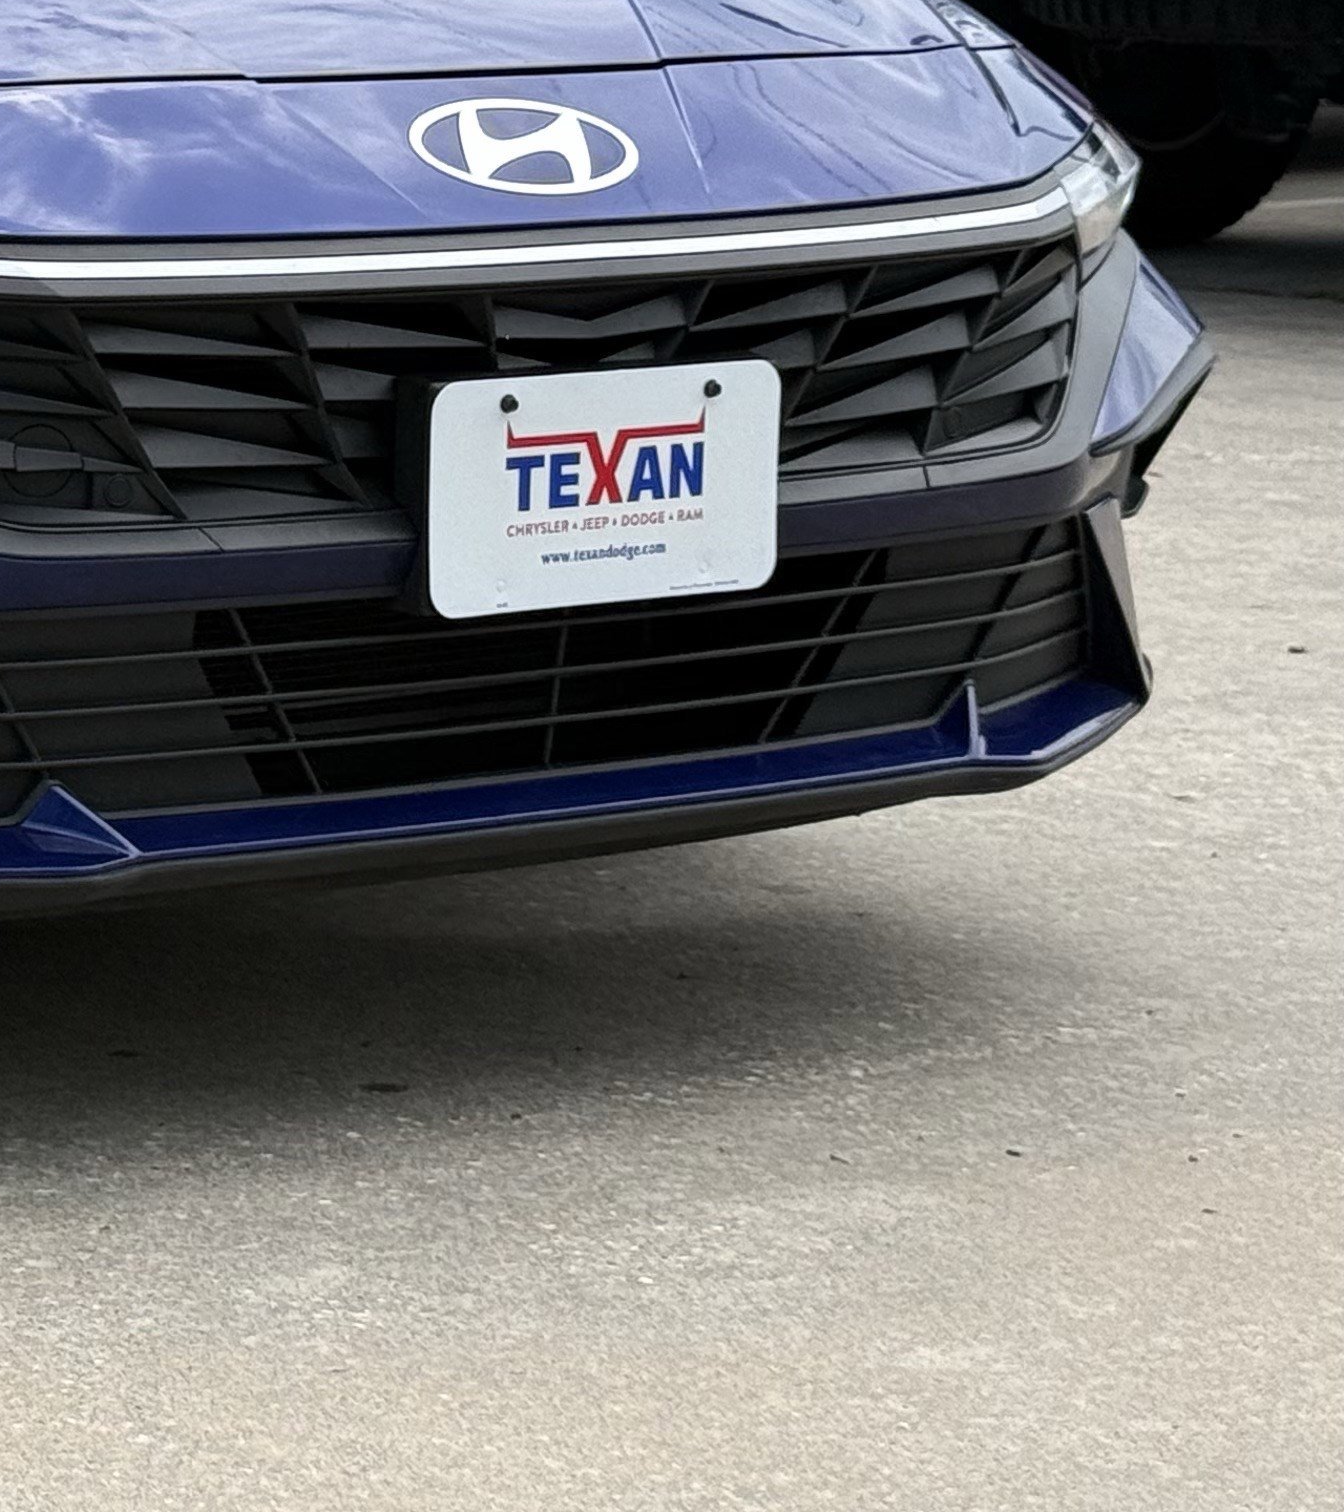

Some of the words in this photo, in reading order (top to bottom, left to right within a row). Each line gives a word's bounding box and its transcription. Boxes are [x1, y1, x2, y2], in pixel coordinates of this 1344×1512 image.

[505, 429, 705, 512] TEXAN
[506, 519, 569, 538] CHRYSLER
[580, 516, 610, 531] JEEP
[621, 510, 666, 528] DODGE
[676, 507, 704, 522] RAM
[540, 542, 667, 565] www.texandodge.com
